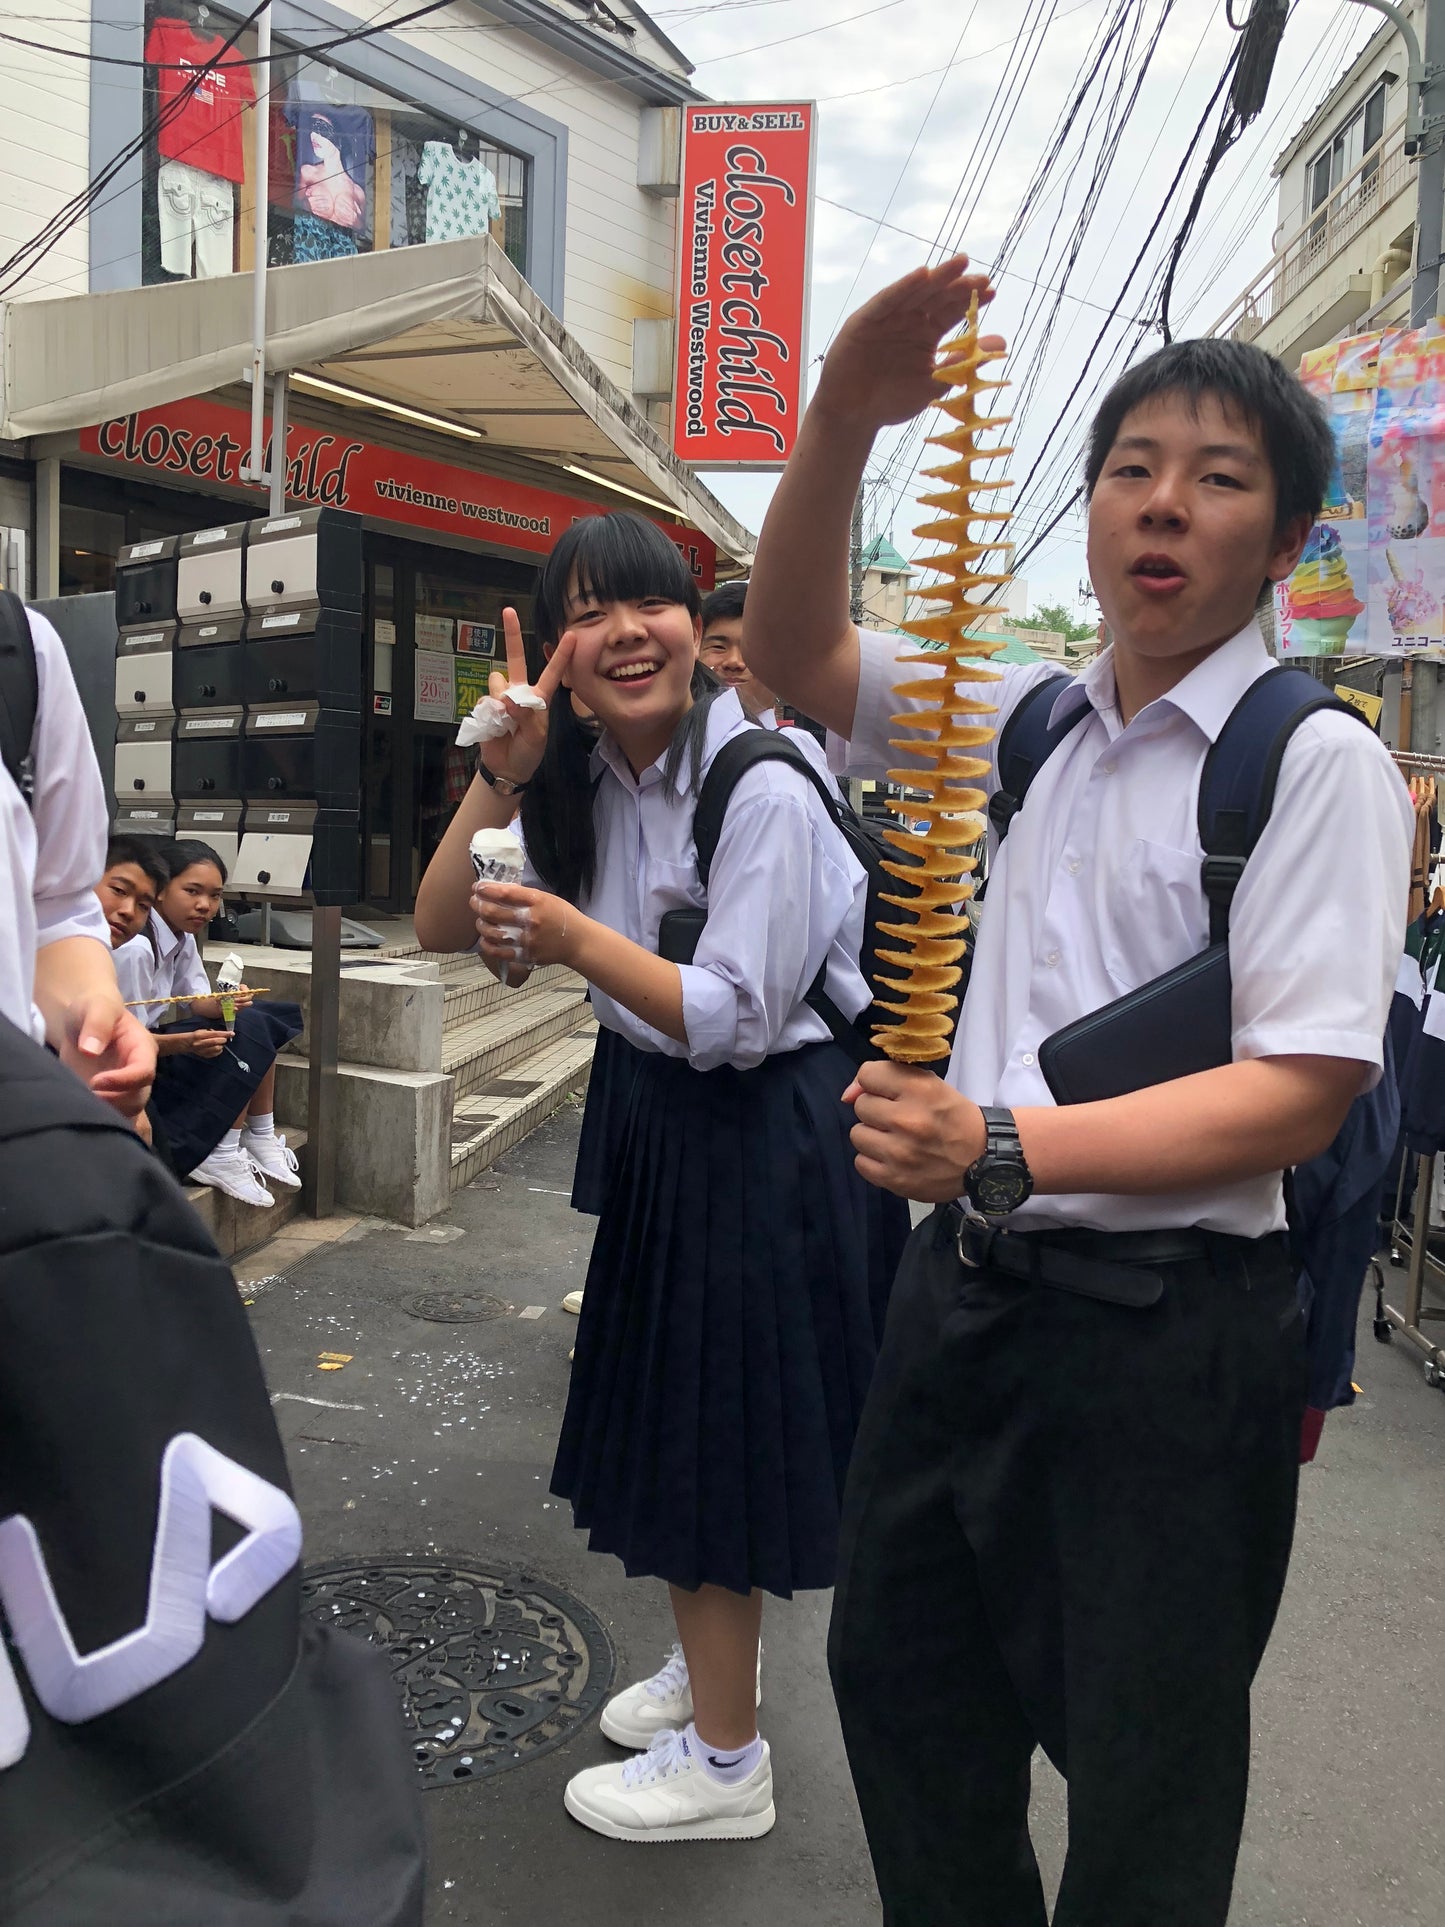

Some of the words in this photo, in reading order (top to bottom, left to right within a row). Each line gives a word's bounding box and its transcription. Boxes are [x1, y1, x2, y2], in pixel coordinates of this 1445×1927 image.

[692, 179, 715, 297] Vivienne
[721, 145, 795, 299] closet
[687, 301, 710, 437] Westwood
[716, 300, 788, 453] child
[99, 413, 239, 481] closet
[376, 479, 458, 513] vivienne
[461, 501, 550, 535] westwood
[1391, 636, 1445, 647] ユニコー
[420, 681, 438, 699] 20
[459, 686, 477, 708] 20
